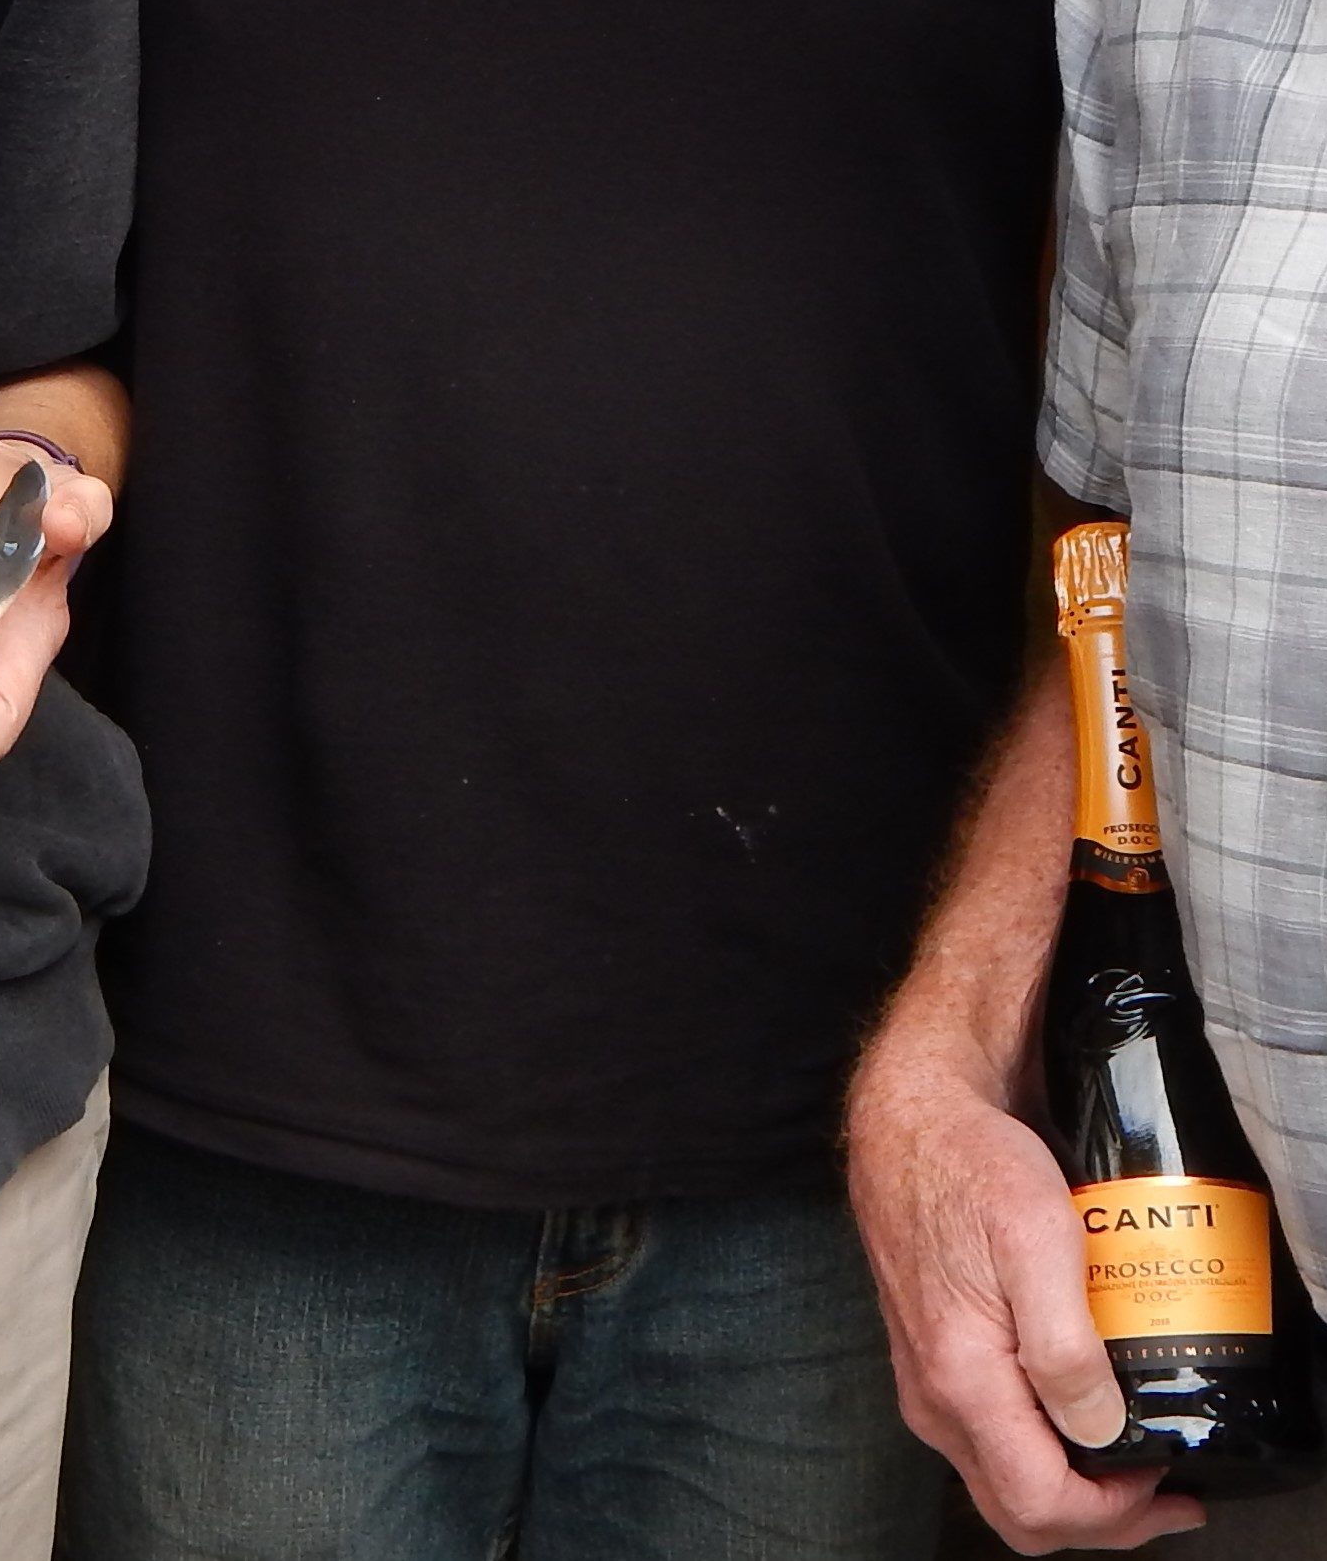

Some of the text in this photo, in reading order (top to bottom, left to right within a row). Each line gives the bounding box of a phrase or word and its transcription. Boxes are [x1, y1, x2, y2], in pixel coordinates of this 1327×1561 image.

[1111, 669, 1142, 790] CANTI
[1103, 823, 1159, 835] PROSECC
[1083, 1204, 1216, 1234] CANTI
[1088, 1258, 1225, 1282] PROSECCO
